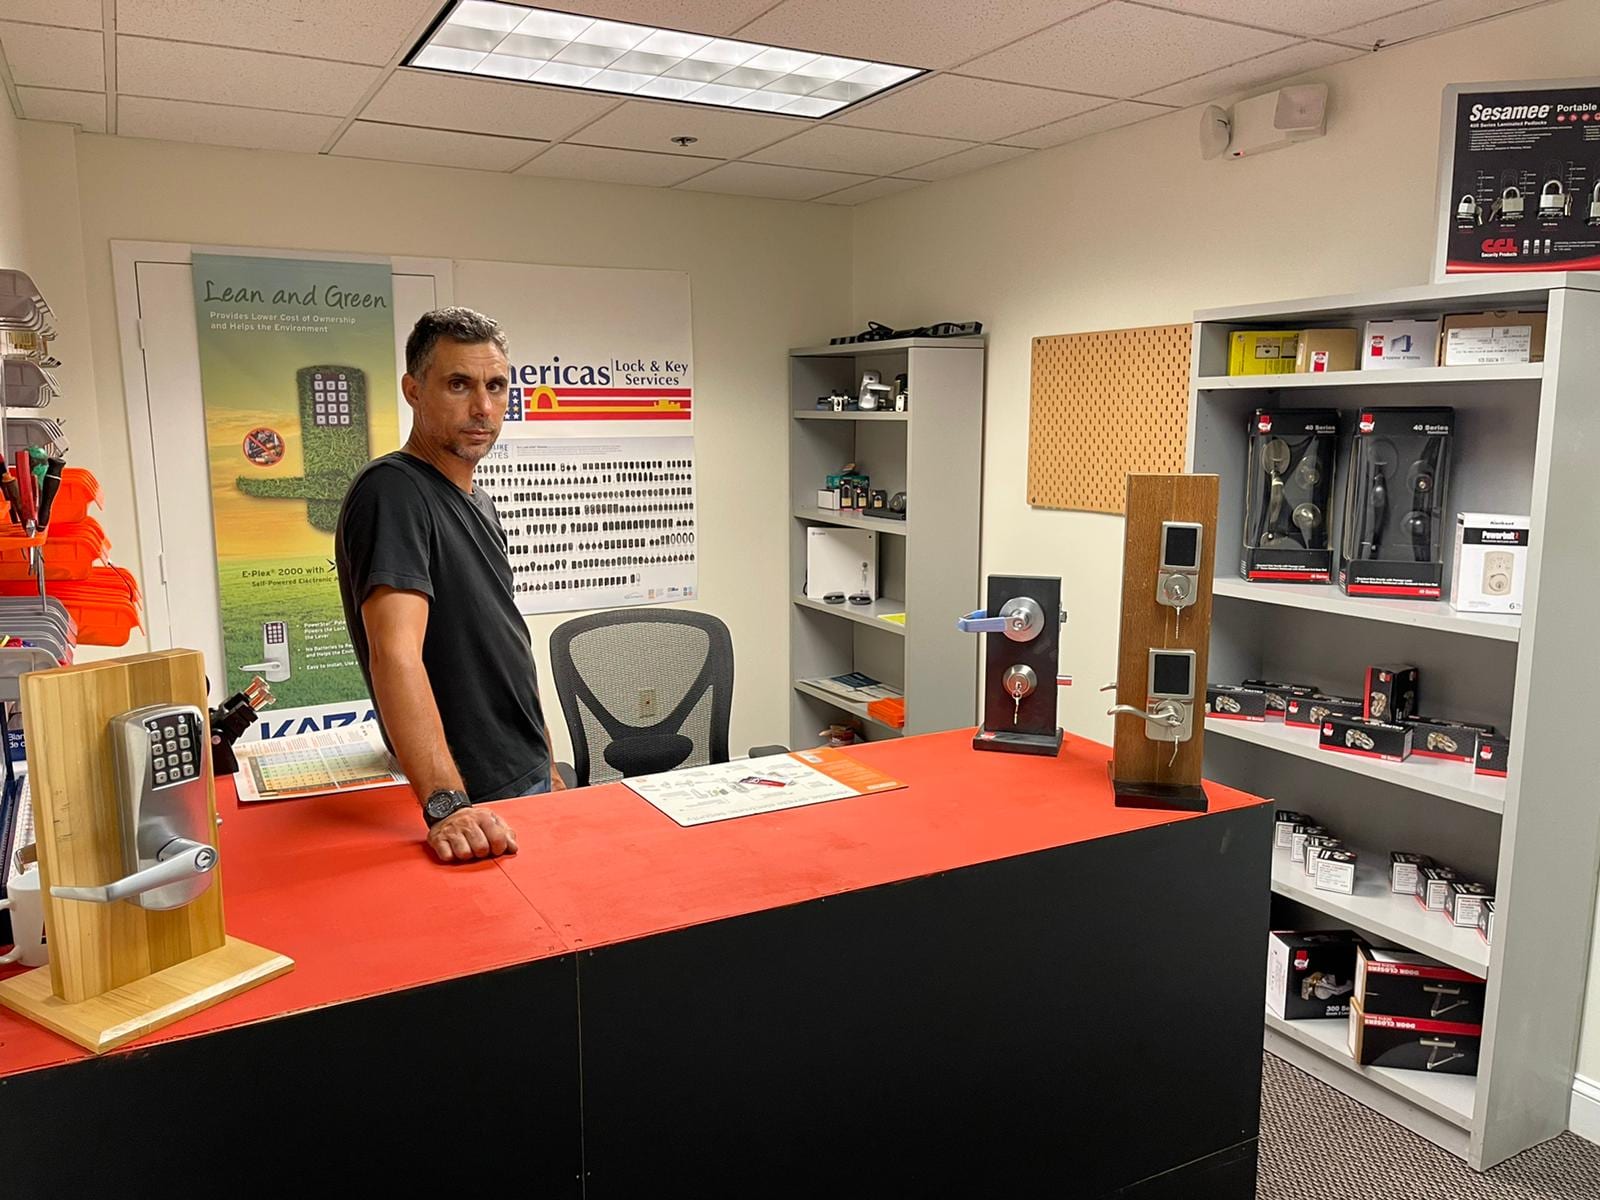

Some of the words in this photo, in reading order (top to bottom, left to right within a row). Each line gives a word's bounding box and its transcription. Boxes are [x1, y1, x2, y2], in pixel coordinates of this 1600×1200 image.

[1469, 104, 1550, 121] Sesamee
[1556, 103, 1598, 113] Portable
[1481, 239, 1518, 252] CCL
[203, 280, 265, 303] Lean
[272, 285, 318, 306] and
[324, 285, 387, 309] Green
[209, 311, 249, 320] Provides
[251, 312, 277, 321] Lower
[280, 313, 299, 321] Cost
[312, 315, 356, 324] Ownership
[210, 322, 227, 330] and
[229, 323, 255, 331] Helps
[274, 324, 328, 333] Environment
[509, 356, 611, 386] ericas
[615, 359, 645, 373] Lock
[650, 360, 660, 372] &
[665, 360, 688, 376] Key
[625, 373, 680, 386] Services
[278, 567, 304, 576] 2000
[305, 566, 325, 574] with
[252, 579, 297, 588] Self-Powered
[298, 576, 332, 585] Electronic
